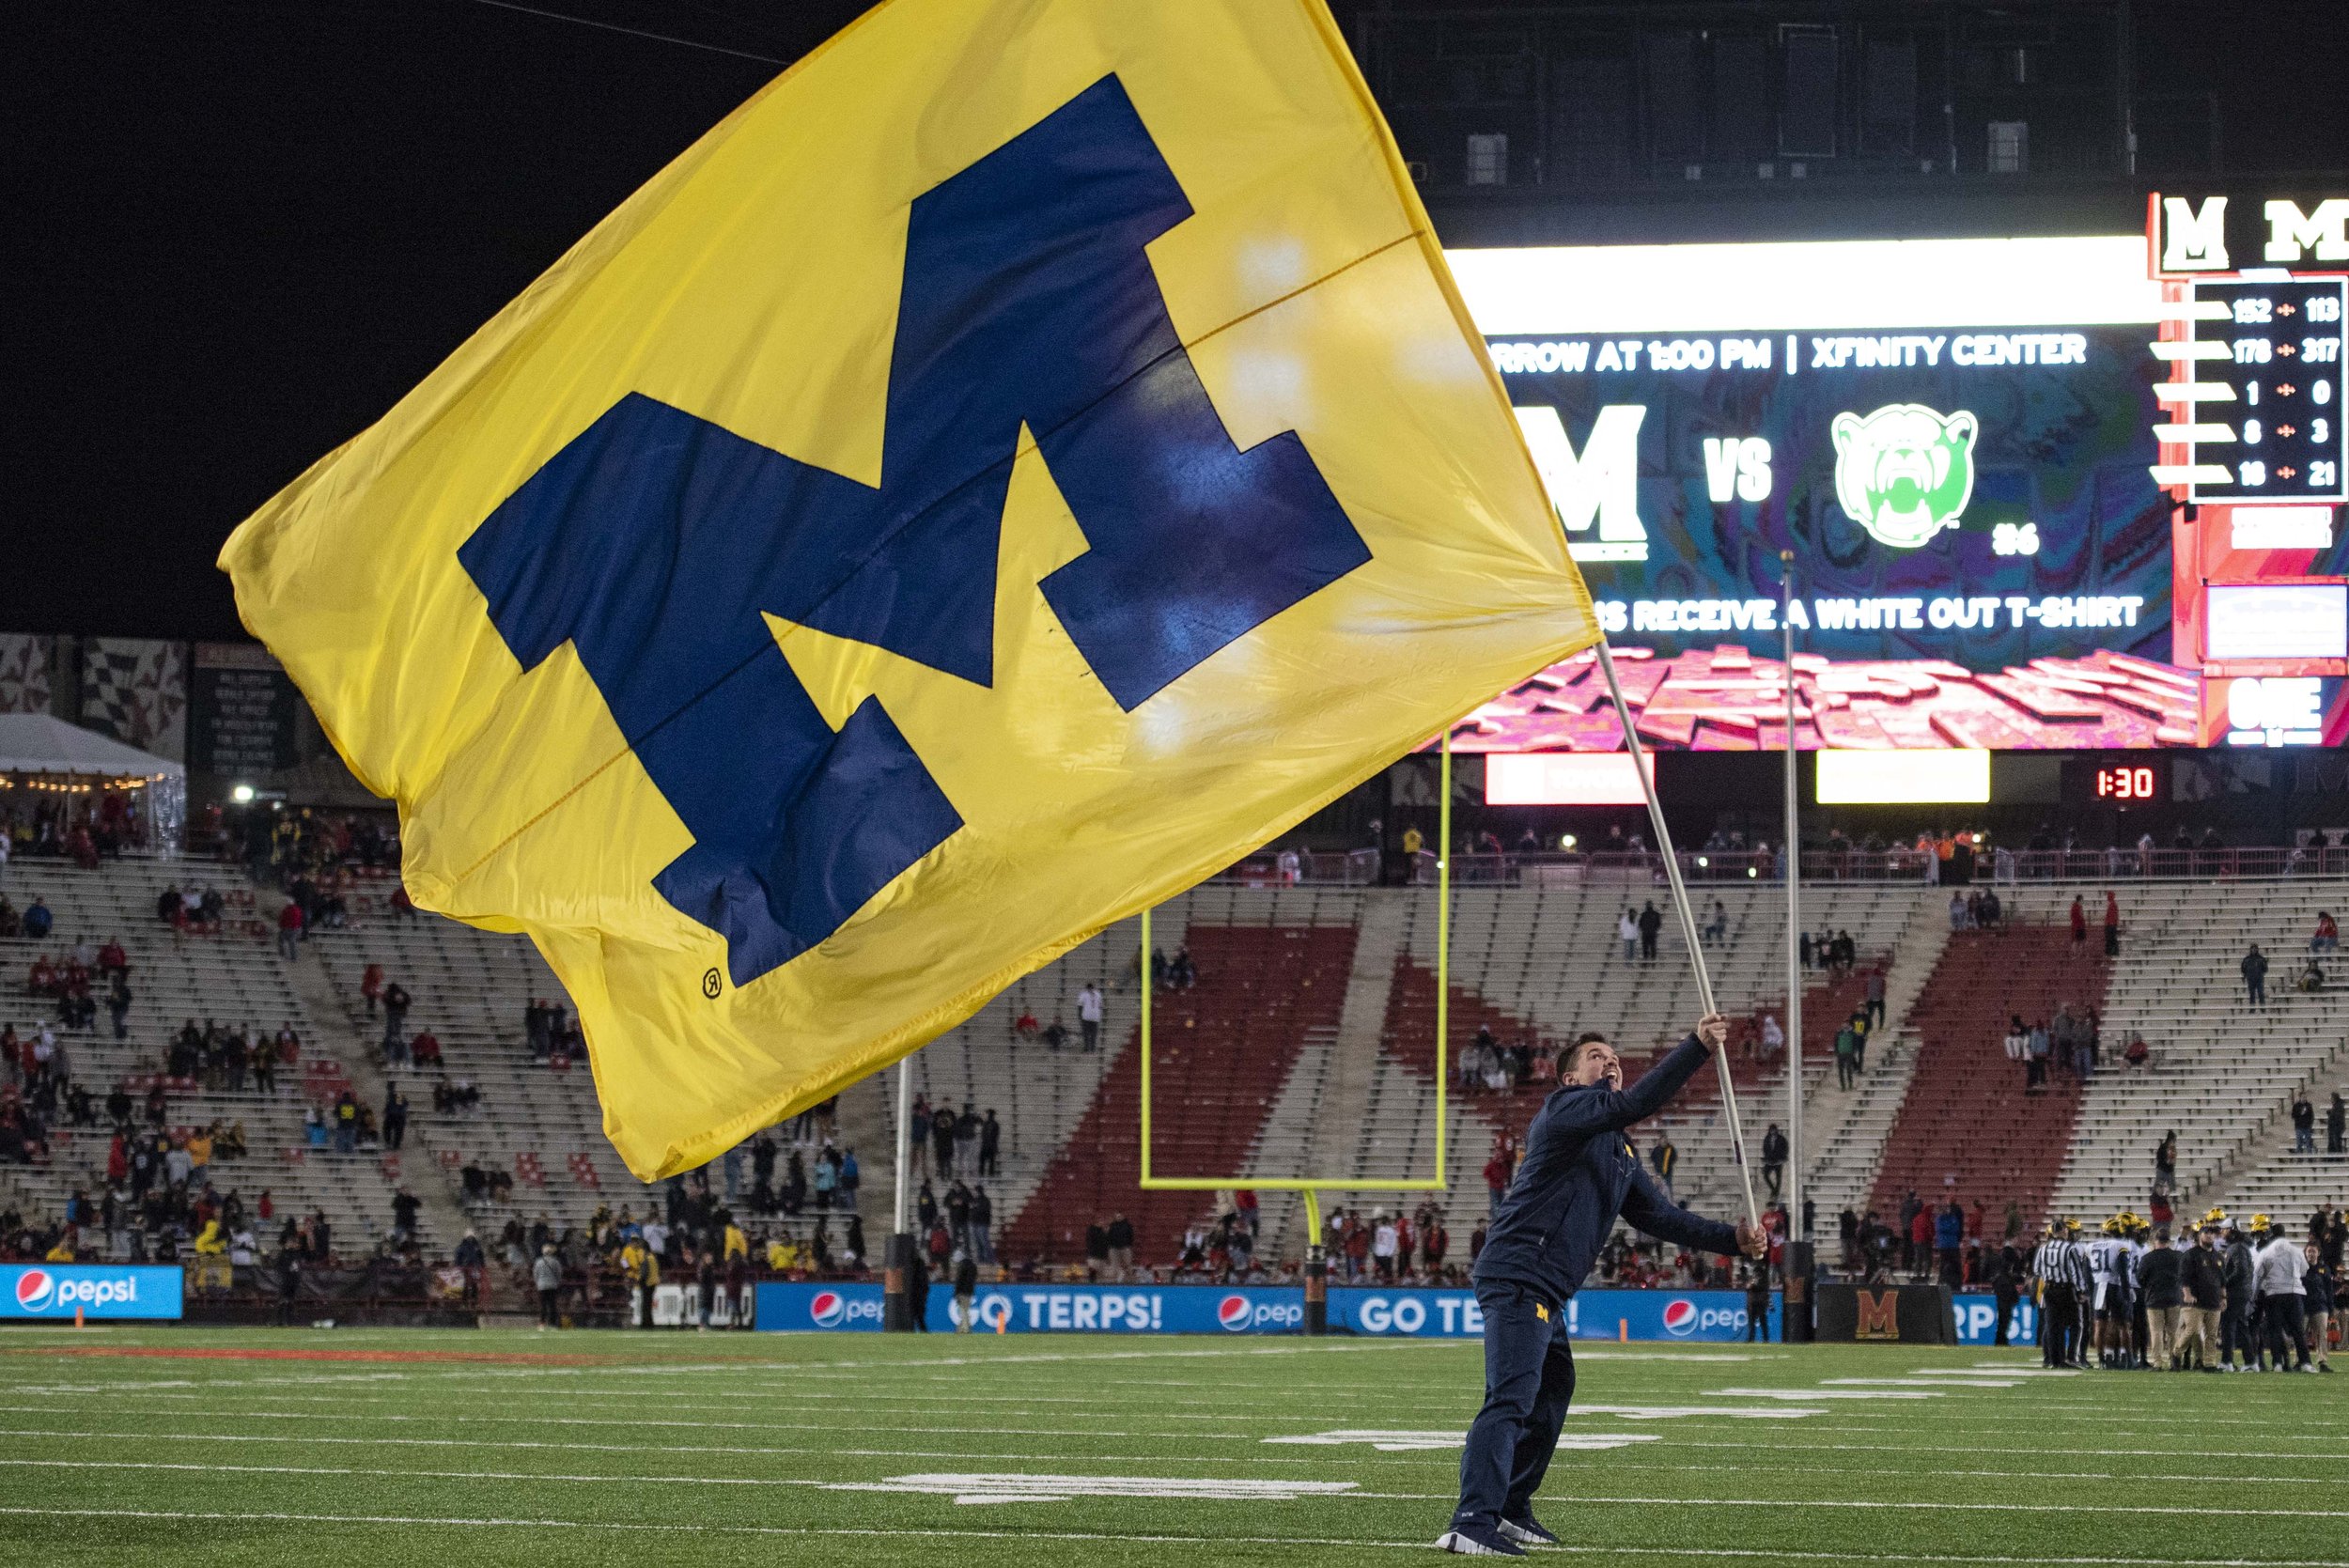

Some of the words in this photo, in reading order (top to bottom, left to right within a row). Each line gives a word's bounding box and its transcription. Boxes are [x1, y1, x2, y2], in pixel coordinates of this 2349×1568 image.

[2163, 196, 2229, 270] M
[2264, 199, 2349, 261] M
[2305, 297, 2340, 322] 113
[1486, 341, 1590, 373] RROW
[1595, 340, 1642, 372] AT
[1648, 339, 1714, 371] 1:00
[1720, 338, 1771, 370] PM
[1812, 335, 1946, 367] XFINITY
[1952, 334, 2086, 365] CENTER
[2301, 337, 2340, 363] 317
[2247, 380, 2258, 405] 1
[2312, 379, 2330, 404] 0
[2311, 418, 2328, 442] 3
[1703, 438, 1771, 502] VS
[2309, 460, 2335, 486] 21
[457, 71, 1373, 987] M
[1992, 522, 2039, 555] #6
[1633, 598, 1776, 631] RECEIVE
[1781, 598, 1810, 629] A
[1815, 598, 1923, 629] WHITE
[1928, 597, 2000, 629] OUT
[2005, 596, 2143, 629] T-SHIRT
[2098, 768, 2153, 798] 1:30
[2091, 1249, 2112, 1273] 31
[57, 1275, 136, 1308] pepsi
[1023, 1294, 1162, 1330] TERPS!
[1253, 1303, 1303, 1327] pep
[1359, 1297, 1426, 1333] GO
[1855, 1290, 1899, 1339] M
